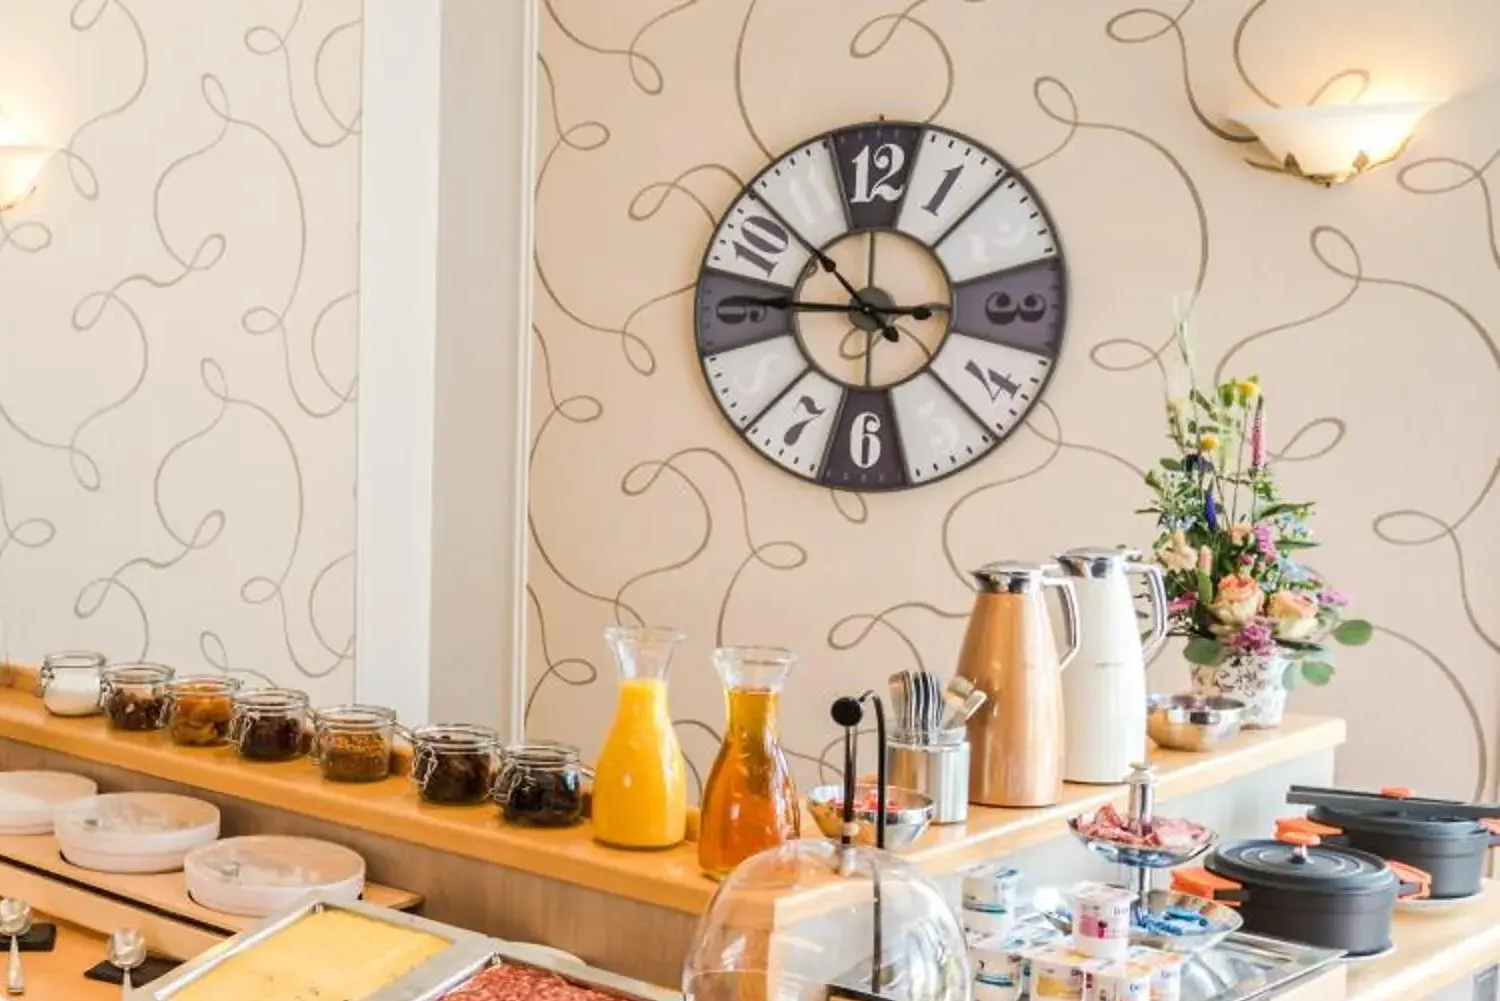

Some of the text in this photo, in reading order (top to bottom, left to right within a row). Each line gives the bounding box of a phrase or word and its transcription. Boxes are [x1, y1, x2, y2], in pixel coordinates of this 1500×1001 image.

[848, 143, 906, 205] 12
[920, 163, 966, 218] 1
[732, 213, 790, 279] 10
[714, 294, 768, 325] 9
[984, 291, 1047, 326] 3
[964, 357, 1023, 403] 4
[783, 394, 827, 448] 7
[849, 410, 882, 470] 6
